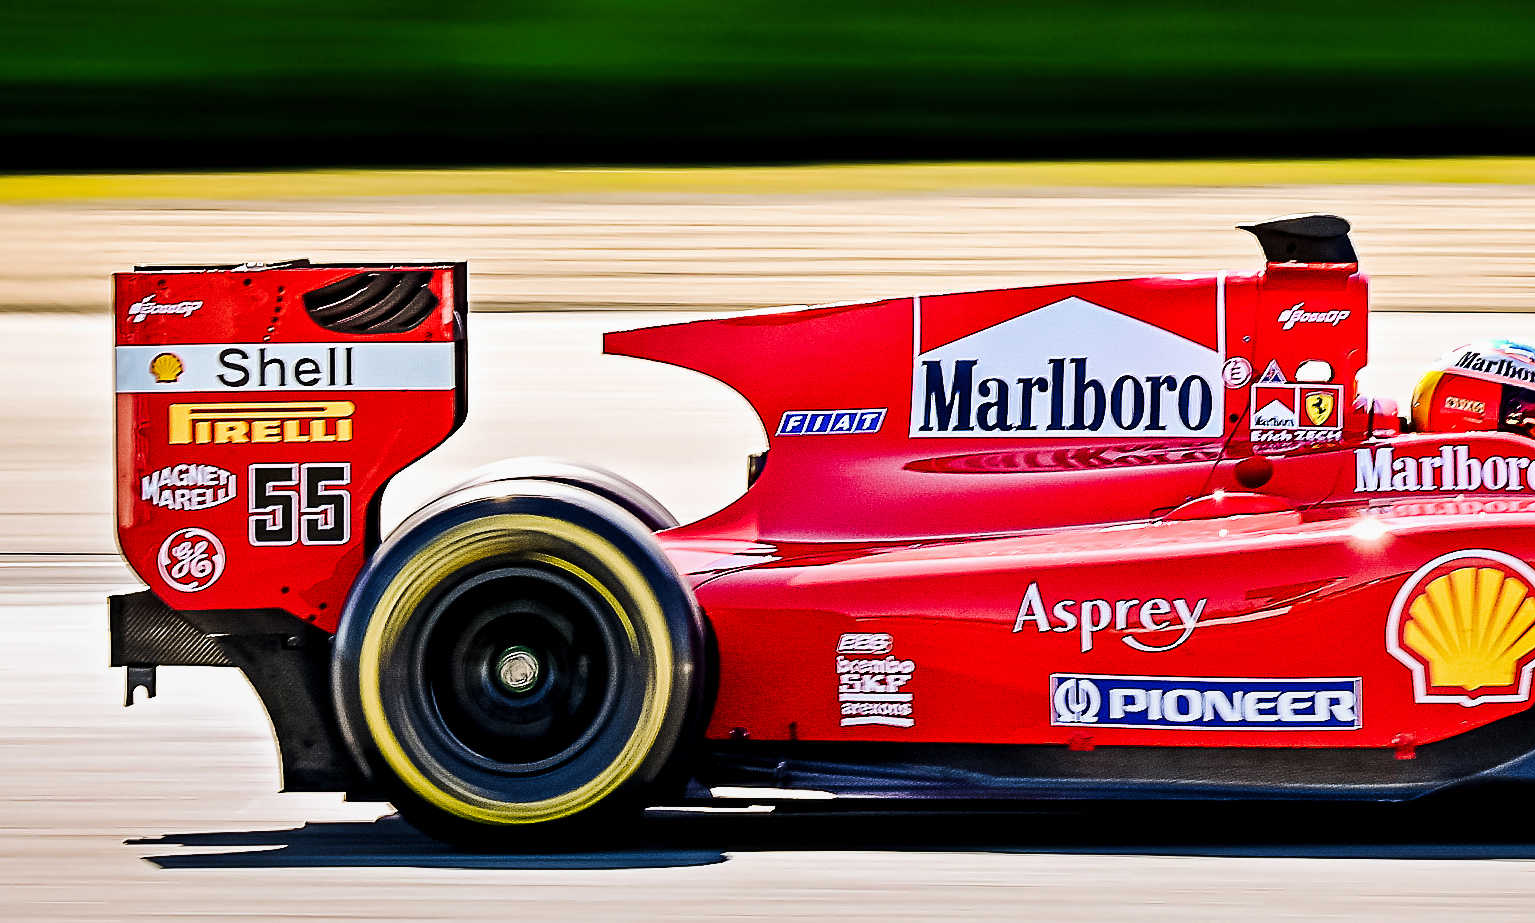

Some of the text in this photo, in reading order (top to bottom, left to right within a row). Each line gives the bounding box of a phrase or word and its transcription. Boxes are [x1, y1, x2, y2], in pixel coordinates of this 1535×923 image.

[216, 347, 353, 387] Shell
[921, 358, 1213, 433] Marlboro
[168, 401, 355, 445] PIRELLI
[784, 413, 880, 432] FIAT
[141, 463, 237, 488] MAGNETI
[248, 463, 351, 546] 55
[1012, 580, 1207, 653] Asprey
[1108, 689, 1357, 723] PIONEER
